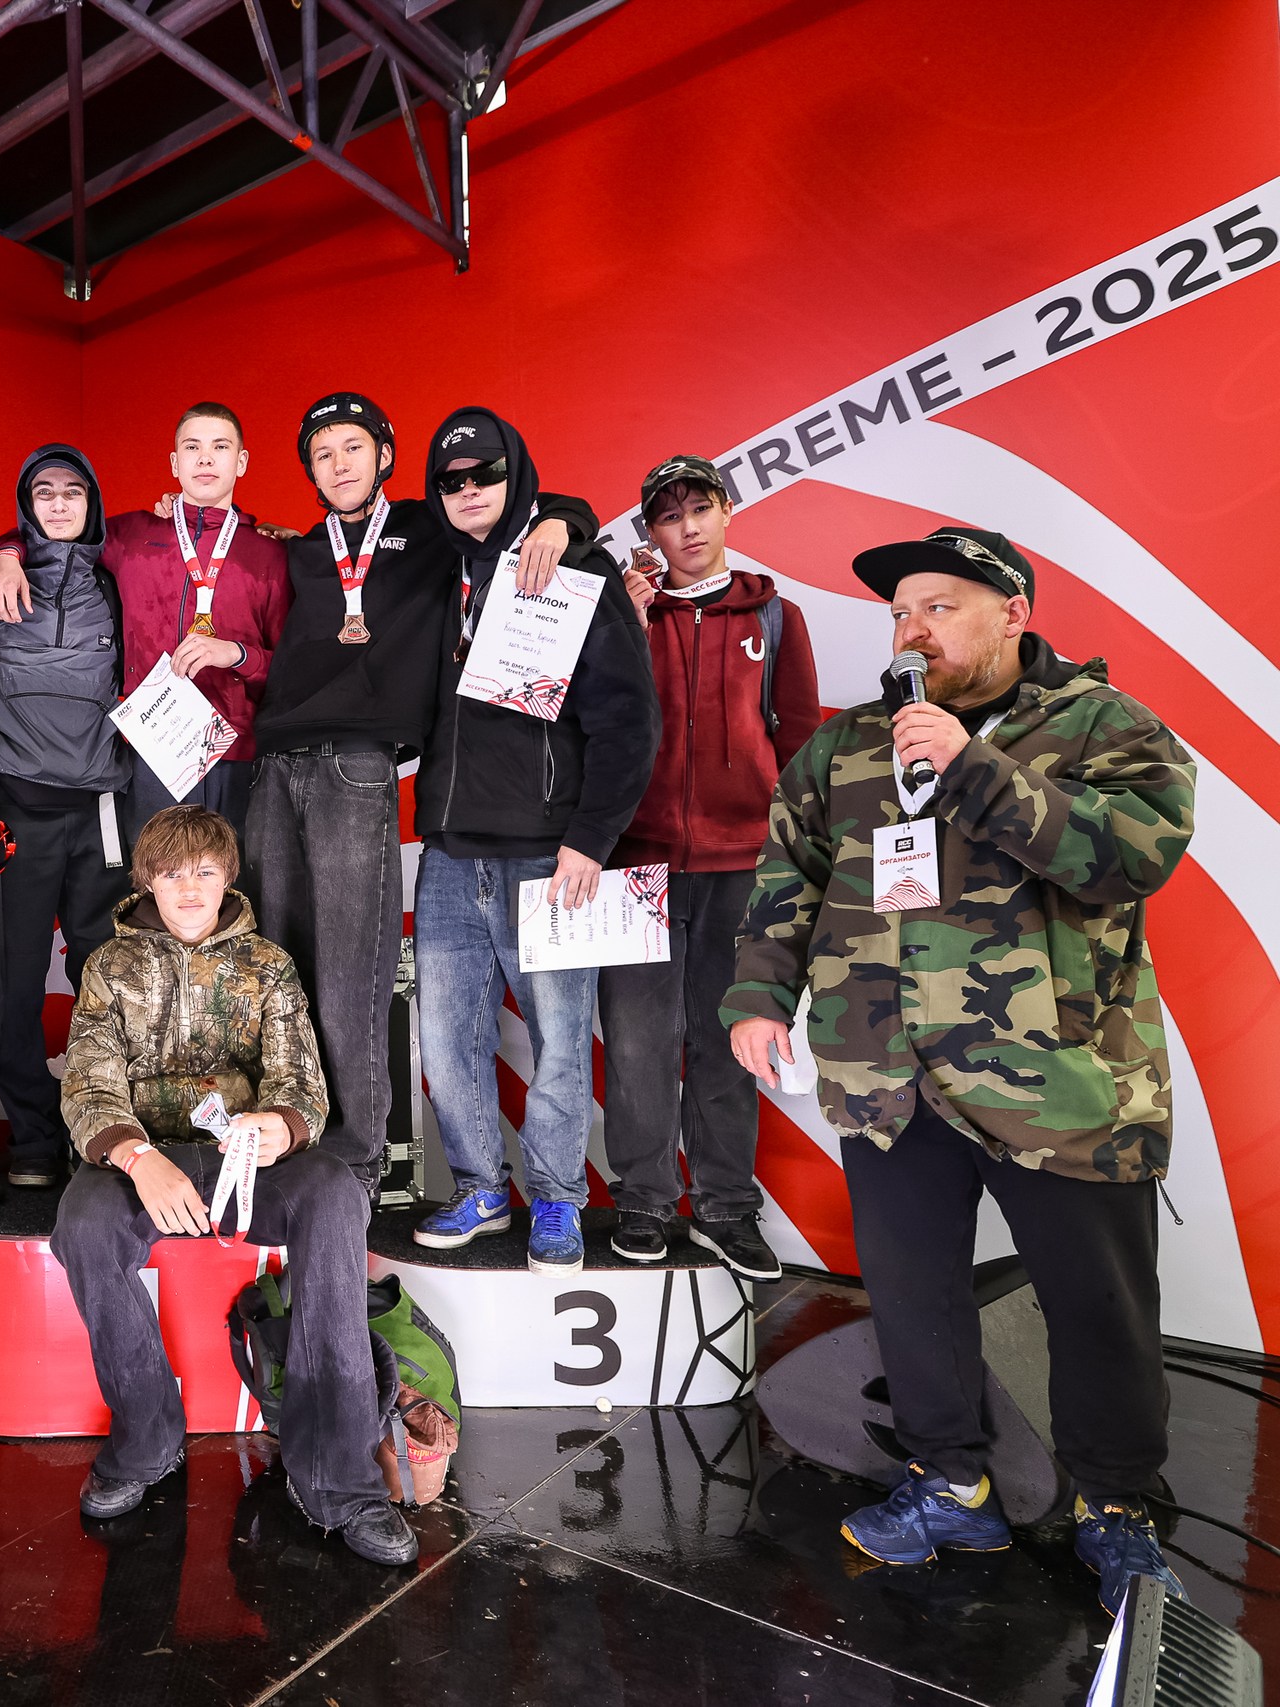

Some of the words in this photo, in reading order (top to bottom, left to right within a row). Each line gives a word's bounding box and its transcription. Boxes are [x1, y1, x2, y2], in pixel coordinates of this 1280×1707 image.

[631, 353, 963, 552] TREME
[1036, 204, 1279, 356] 2025
[220, 538, 229, 551] 2025
[378, 537, 407, 551] VANS
[690, 584, 705, 593] RCC
[514, 588, 569, 611] Диплом
[514, 607, 523, 615] за
[535, 613, 559, 624] место
[139, 686, 172, 725] Диплом
[162, 699, 177, 716] место
[879, 852, 931, 866] ОРГАНИЗАТОР
[548, 899, 561, 946] Диплом
[246, 1132, 256, 1152] RCC
[242, 1152, 254, 1188] Extreme
[241, 1189, 250, 1212] 2025
[552, 1289, 622, 1387] 3
